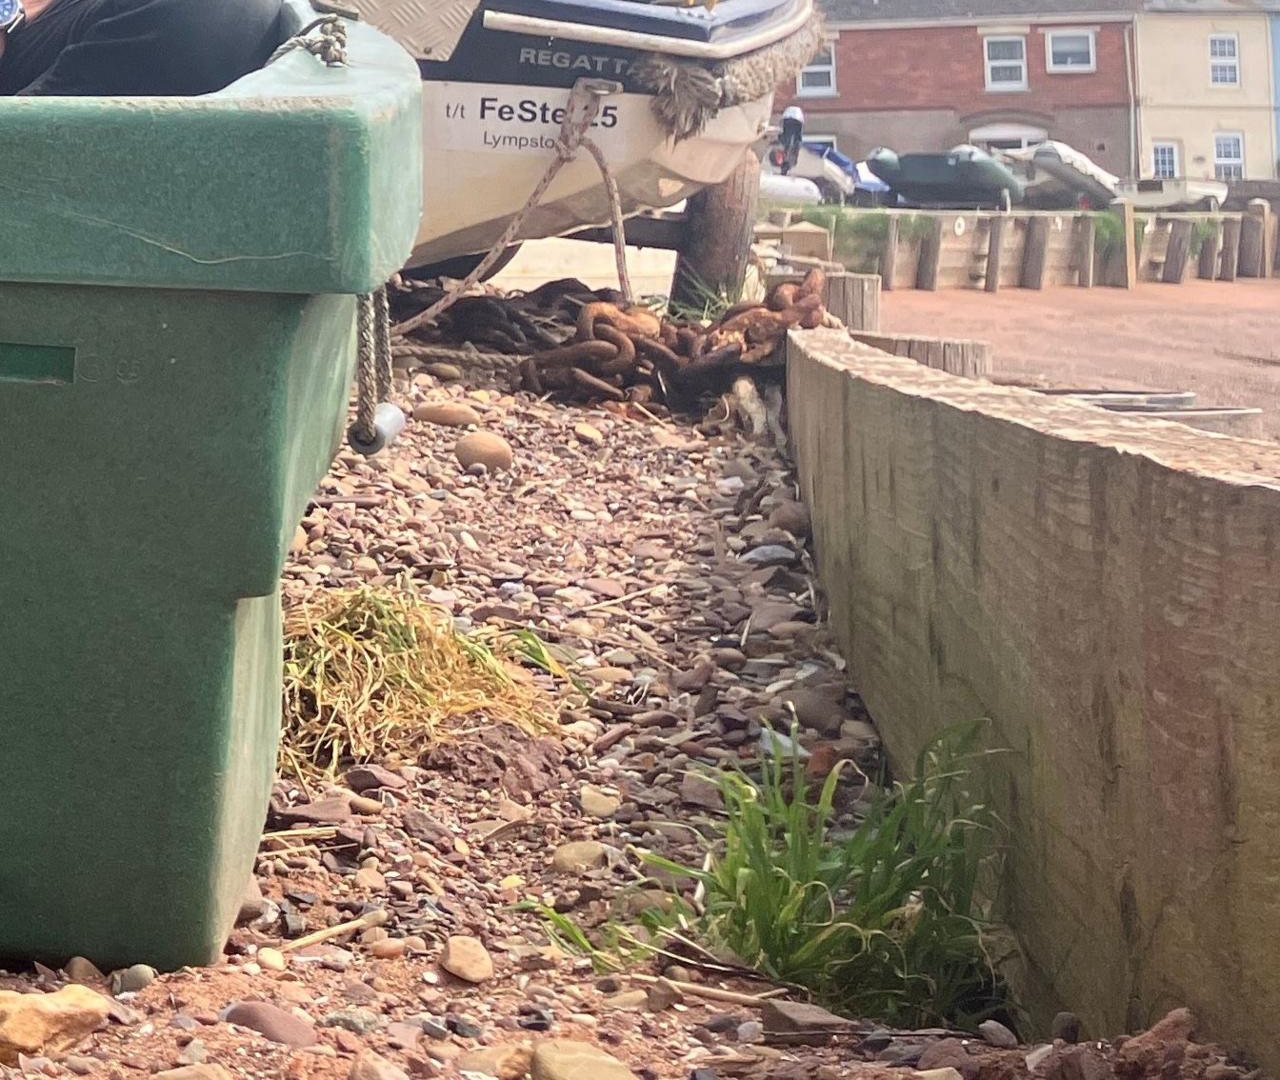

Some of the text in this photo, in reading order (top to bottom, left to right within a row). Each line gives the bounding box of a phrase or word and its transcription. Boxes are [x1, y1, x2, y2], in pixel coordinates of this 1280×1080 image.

[445, 102, 465, 119] t/t
[479, 97, 568, 124] FeSte
[483, 130, 556, 149] Lympsto
